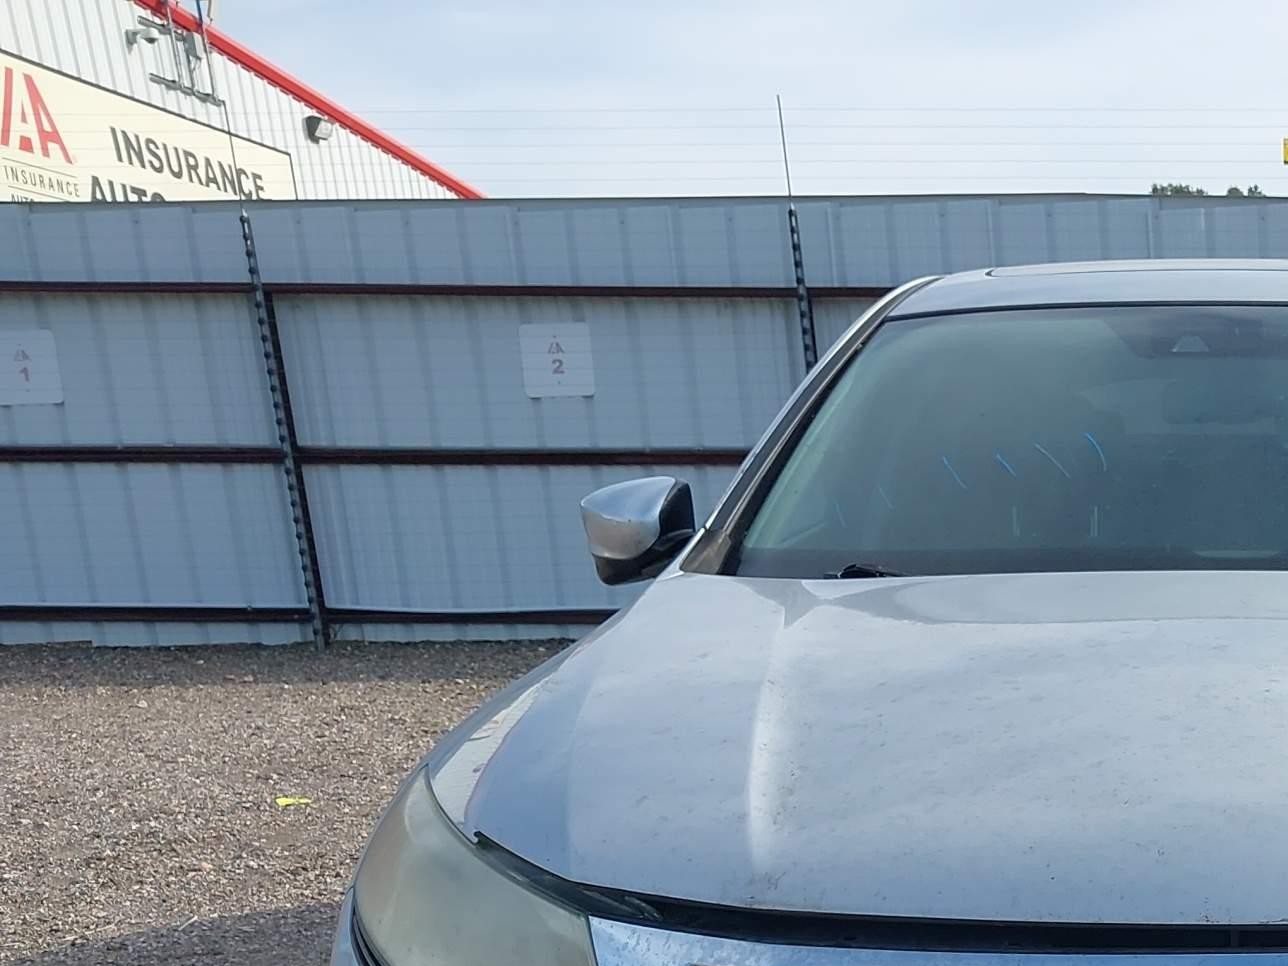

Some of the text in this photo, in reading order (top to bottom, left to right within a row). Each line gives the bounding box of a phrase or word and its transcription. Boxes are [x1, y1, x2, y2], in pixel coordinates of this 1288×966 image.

[110, 126, 267, 200] INSURANCE
[4, 165, 80, 198] INSURANCE
[91, 175, 166, 201] AUT
[20, 367, 30, 382] 1
[552, 359, 565, 375] 2
